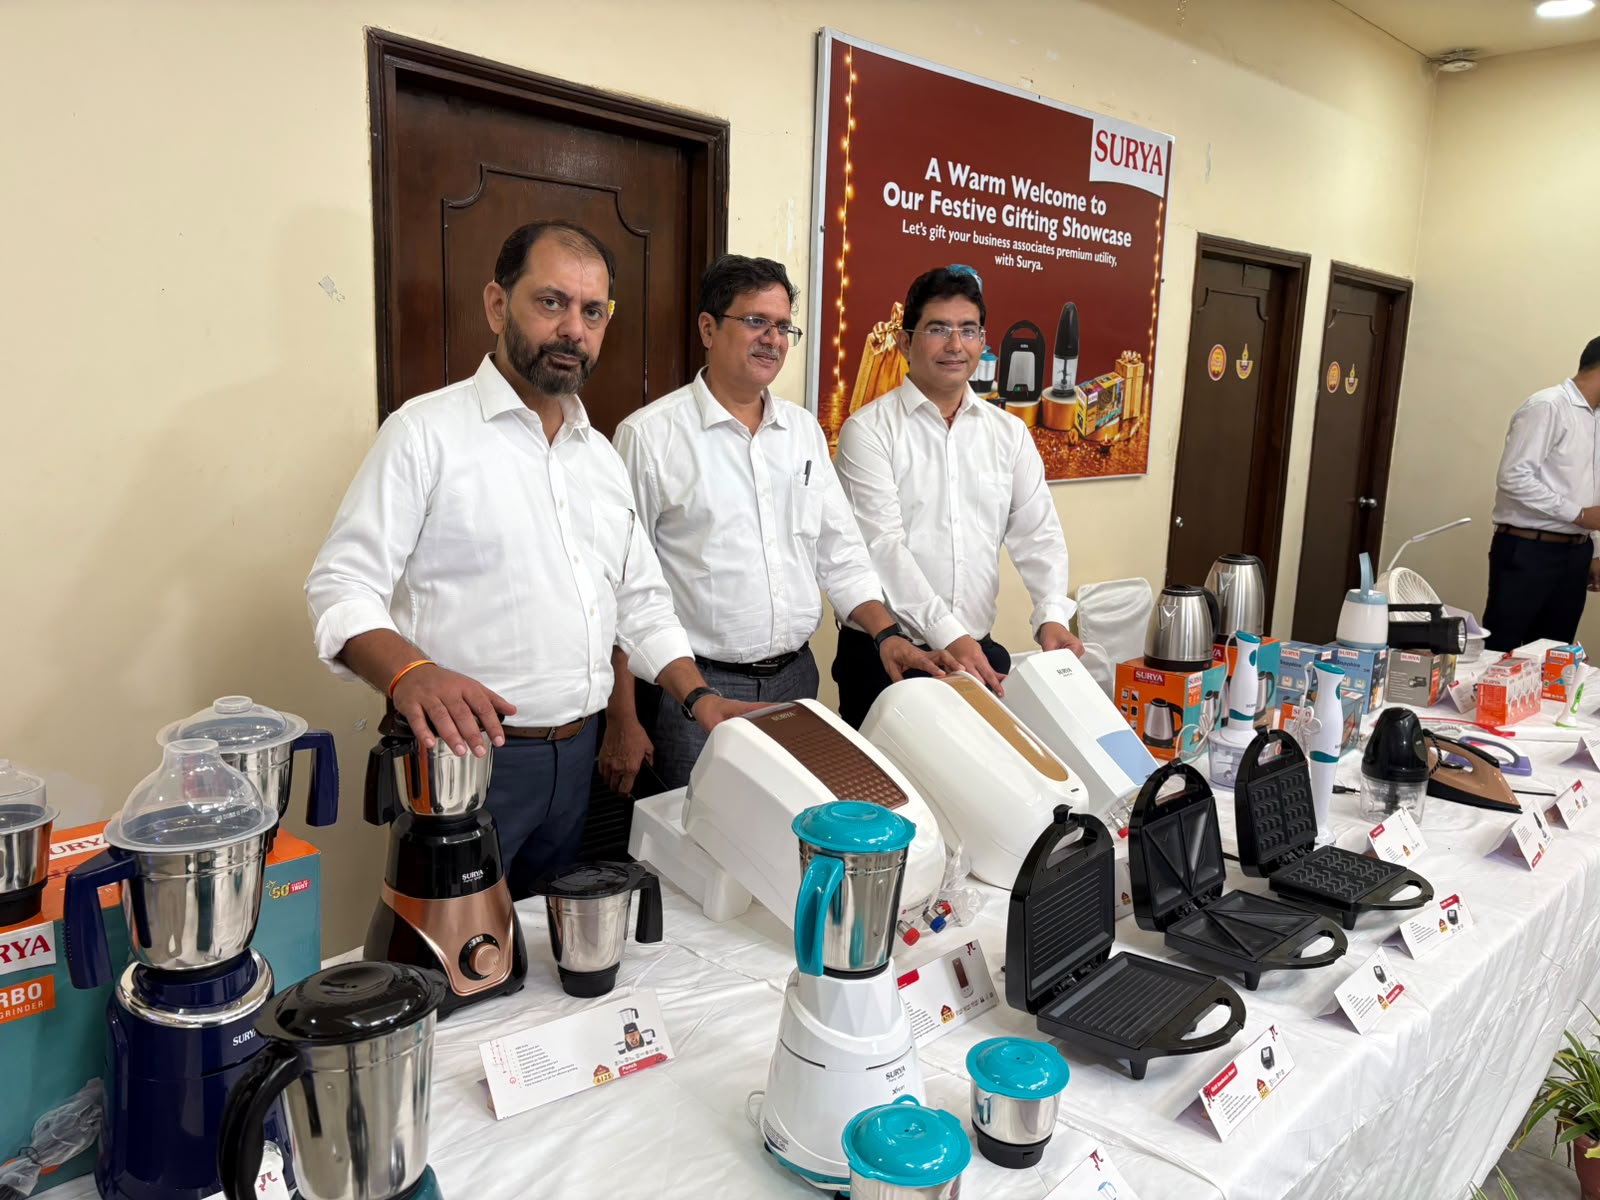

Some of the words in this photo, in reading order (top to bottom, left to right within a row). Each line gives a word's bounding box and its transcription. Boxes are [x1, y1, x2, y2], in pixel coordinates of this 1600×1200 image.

[1094, 129, 1164, 176] SURYA
[924, 157, 942, 183] A
[947, 160, 1006, 196] Warm
[1011, 175, 1087, 212] Welcome
[1090, 194, 1107, 216] to
[883, 181, 925, 211] Our
[929, 189, 997, 224] Festive
[1001, 204, 1059, 241] Gifting
[1062, 215, 1132, 248] Showcase
[902, 219, 927, 236] Let's
[929, 224, 947, 241] gift
[948, 230, 971, 244] your
[972, 230, 1011, 249] business
[1012, 240, 1055, 256] associates
[1056, 247, 1093, 260] premium
[1094, 251, 1118, 268] utility,
[994, 253, 1014, 267] with
[1016, 255, 1044, 273] Surya.
[1135, 671, 1164, 682] SURYA
[770, 711, 795, 721] SURYA
[49, 837, 108, 855] URY
[461, 869, 485, 882] SURYA
[272, 884, 290, 899] 50
[291, 882, 308, 892] TRUST
[885, 1065, 906, 1081] SURYA
